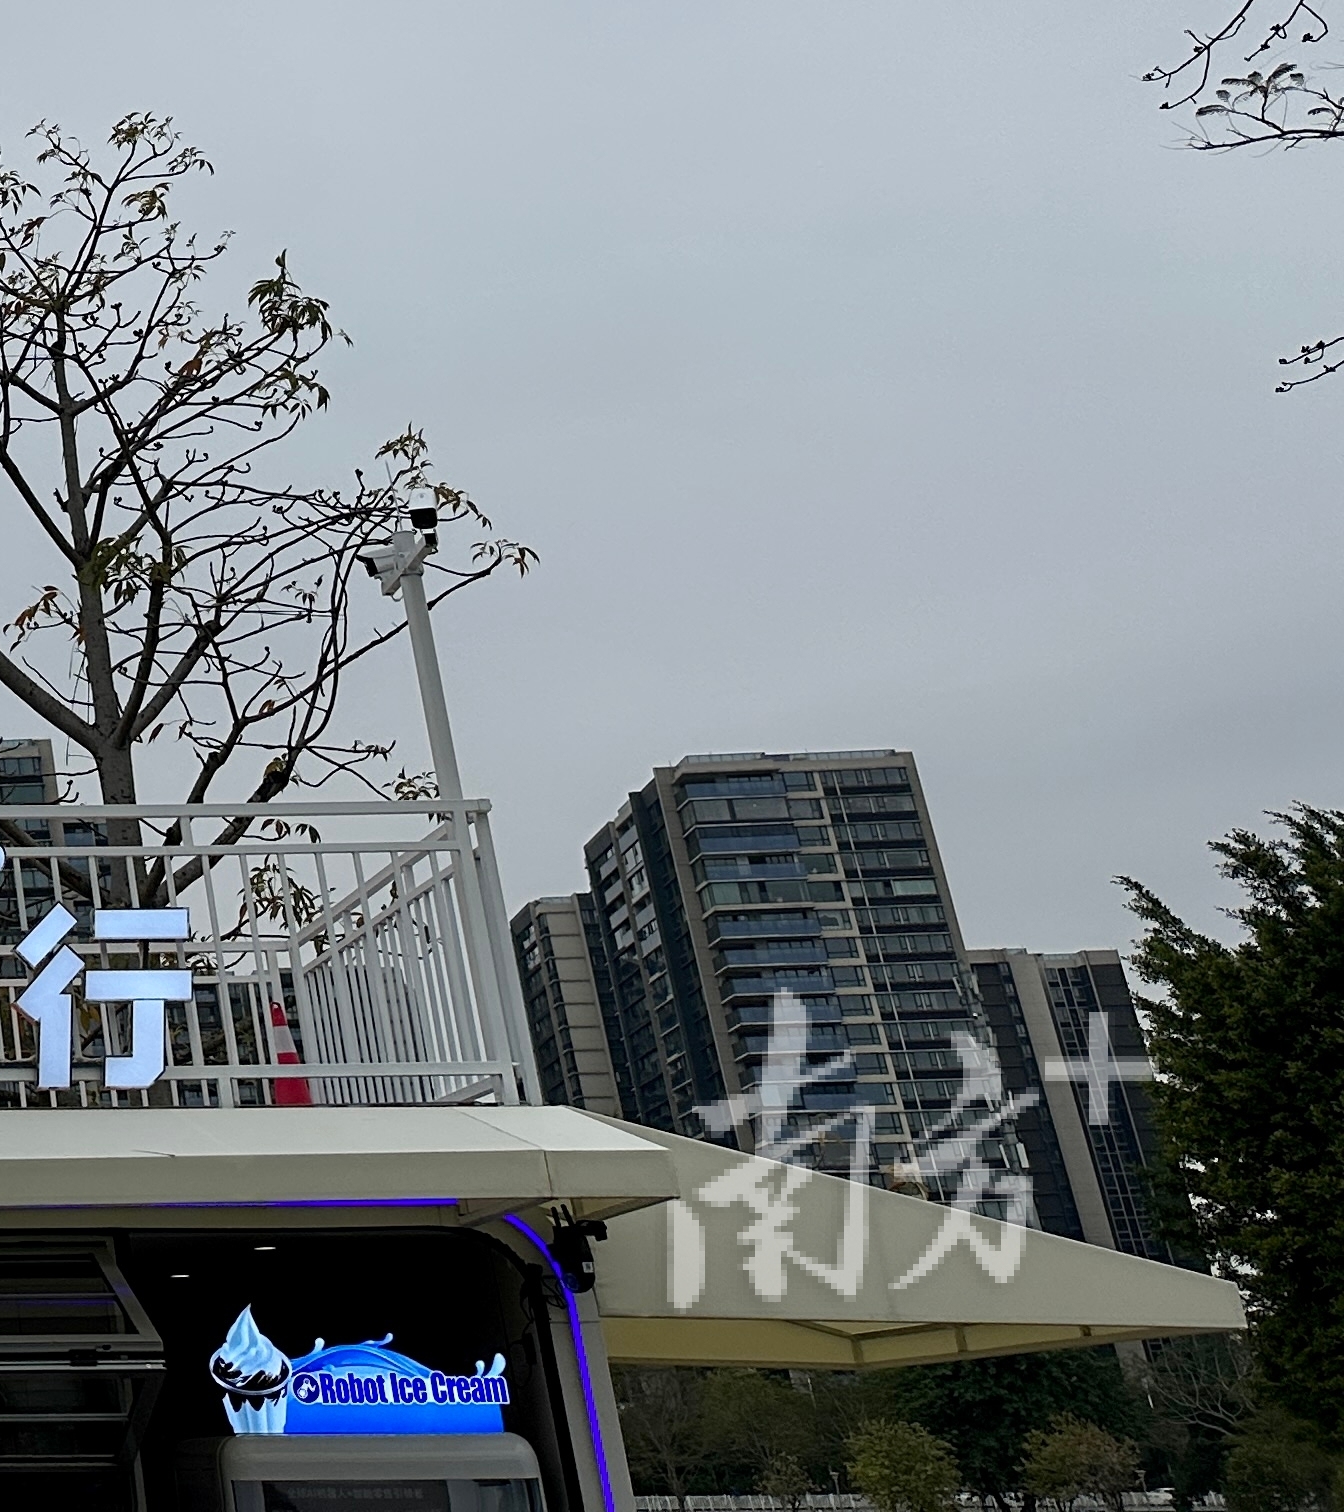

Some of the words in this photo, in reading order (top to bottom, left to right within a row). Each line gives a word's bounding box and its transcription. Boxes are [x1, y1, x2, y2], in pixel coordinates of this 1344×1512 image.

[319, 1372, 388, 1404] Robot
[389, 1372, 428, 1404] Ice
[429, 1370, 509, 1404] Cream
